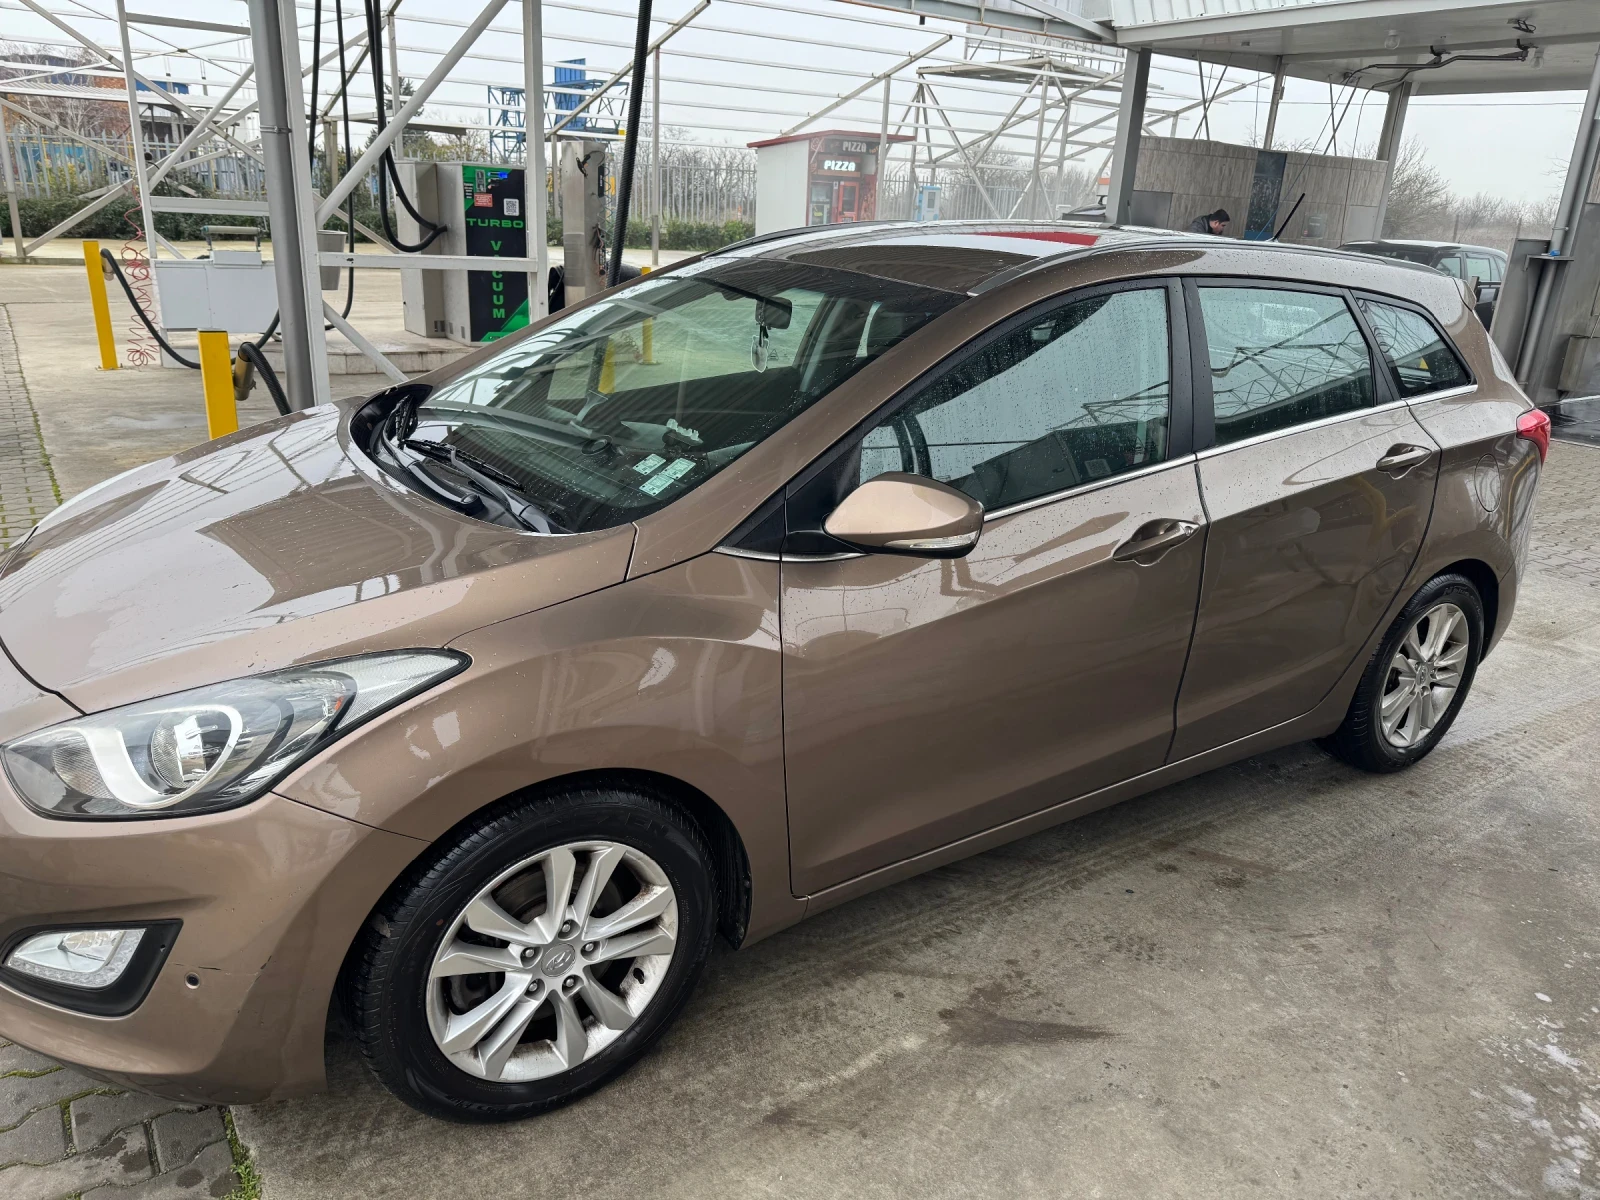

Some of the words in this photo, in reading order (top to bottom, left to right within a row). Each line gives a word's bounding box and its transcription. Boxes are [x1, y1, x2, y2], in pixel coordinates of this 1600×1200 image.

[843, 141, 867, 152] PIZZA
[824, 160, 856, 171] PIZZA
[466, 218, 524, 228] TURBO
[490, 240, 505, 319] VCUUM
